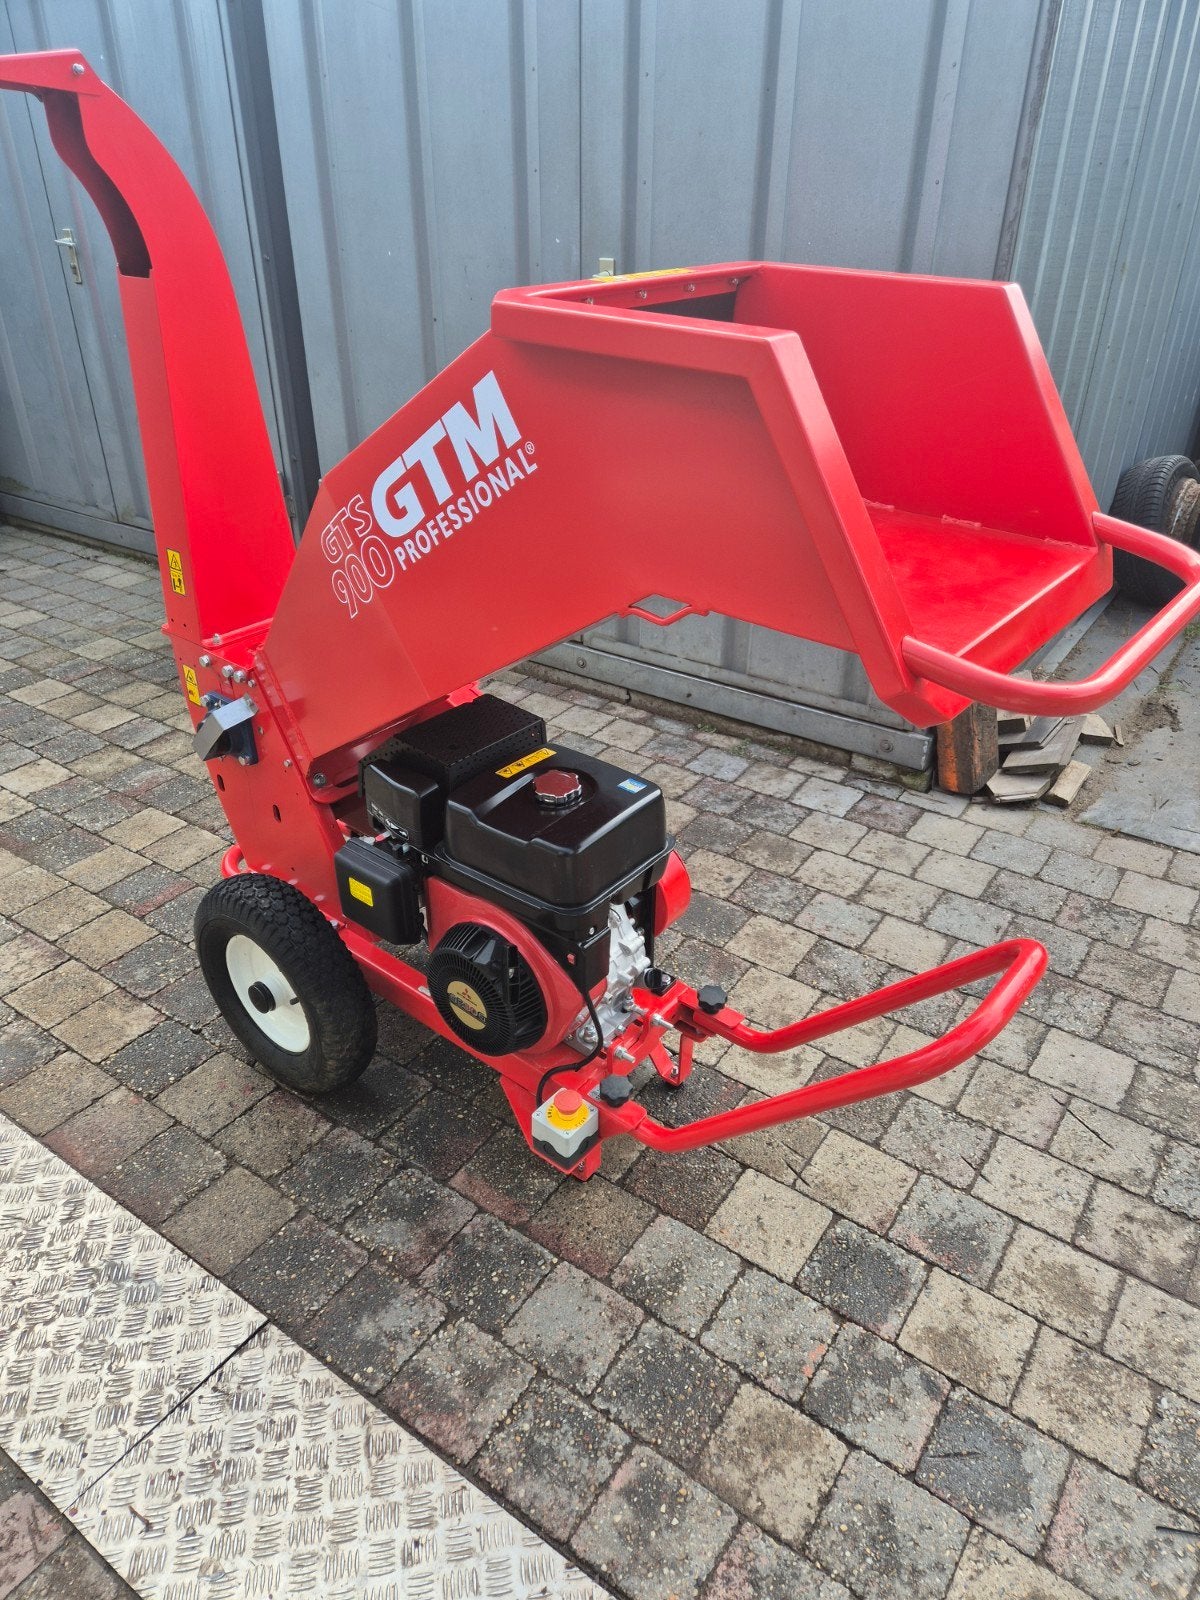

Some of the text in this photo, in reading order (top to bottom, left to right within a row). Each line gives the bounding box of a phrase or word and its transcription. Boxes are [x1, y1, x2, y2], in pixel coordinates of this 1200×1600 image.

[371, 370, 522, 538] GTM
[320, 494, 373, 564] GTS
[331, 535, 395, 619] 900
